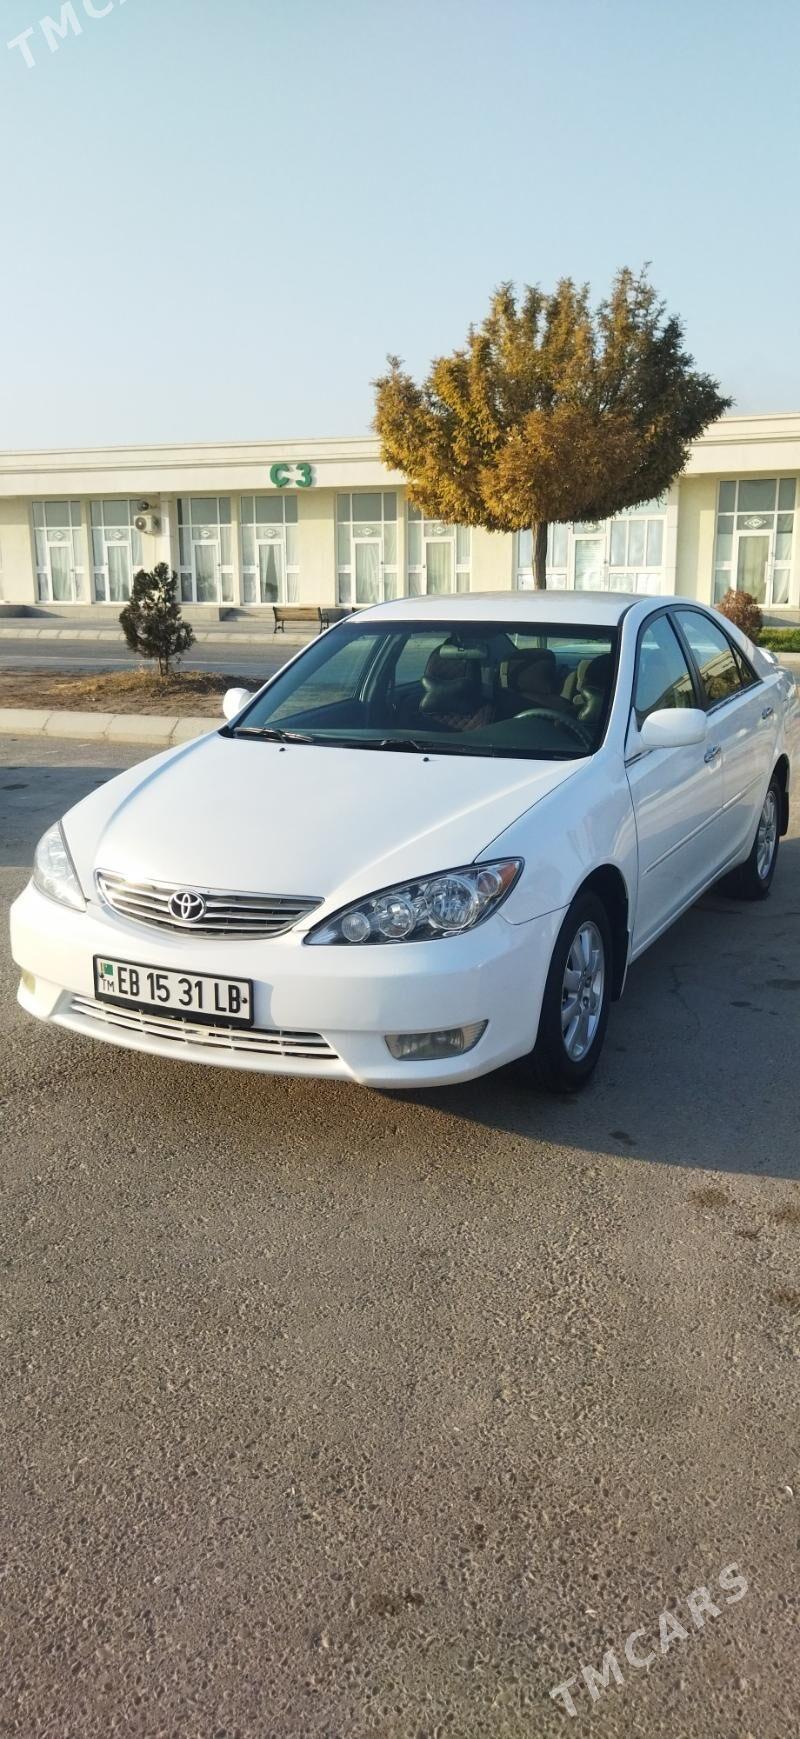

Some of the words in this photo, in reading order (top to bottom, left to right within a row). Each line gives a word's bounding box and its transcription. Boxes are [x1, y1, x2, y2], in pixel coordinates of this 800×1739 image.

[102, 978, 115, 993] TM
[117, 966, 140, 997] EB
[146, 972, 171, 1003] 15
[178, 977, 203, 1009] 31
[214, 982, 241, 1014] LB
